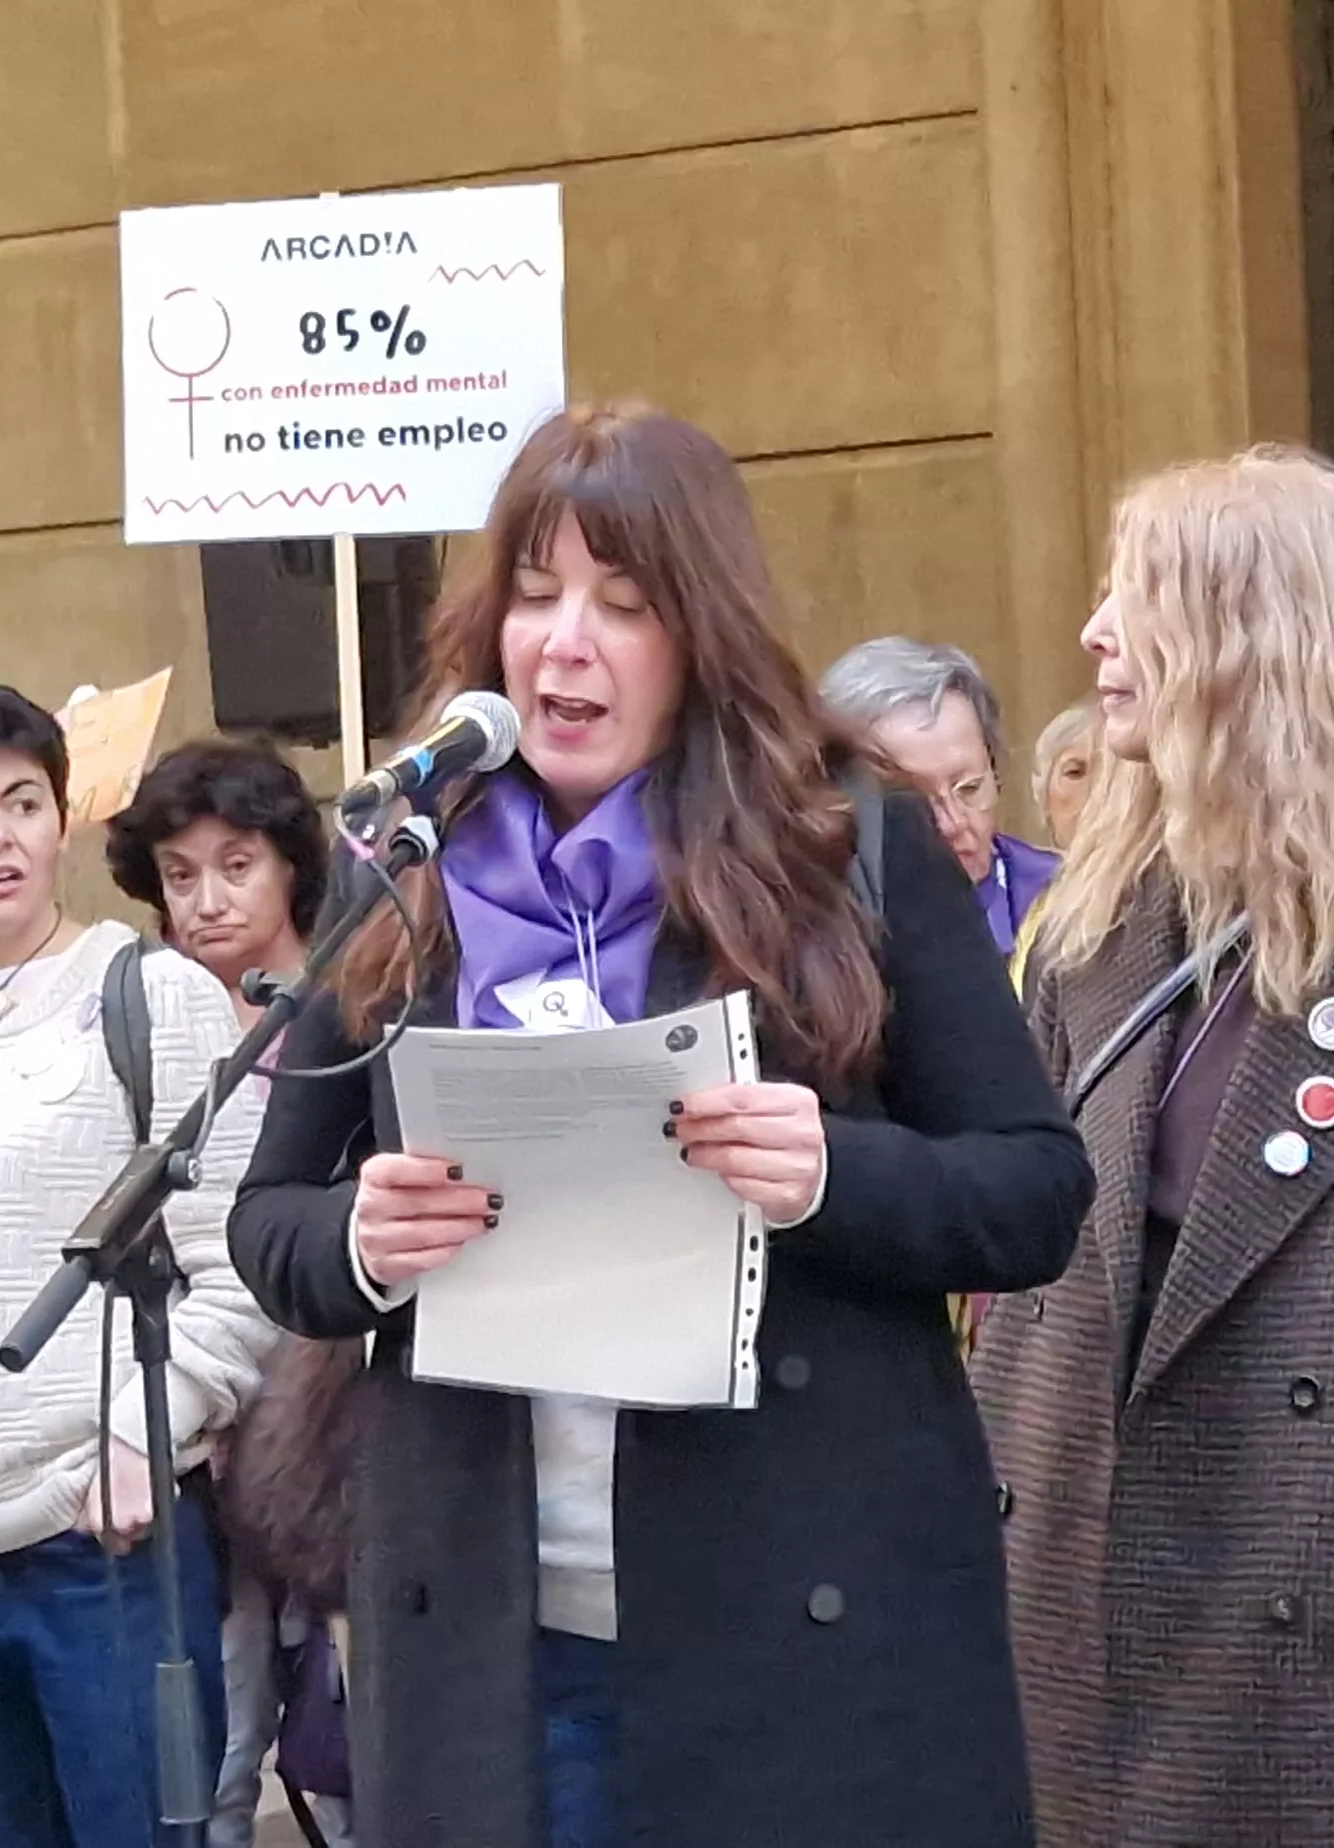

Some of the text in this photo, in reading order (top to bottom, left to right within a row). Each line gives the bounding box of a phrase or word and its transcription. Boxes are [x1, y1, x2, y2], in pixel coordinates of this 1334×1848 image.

[299, 304, 427, 359] 85%
[221, 370, 508, 402] con enfermedad mental
[224, 416, 509, 453] no tiene empleo
